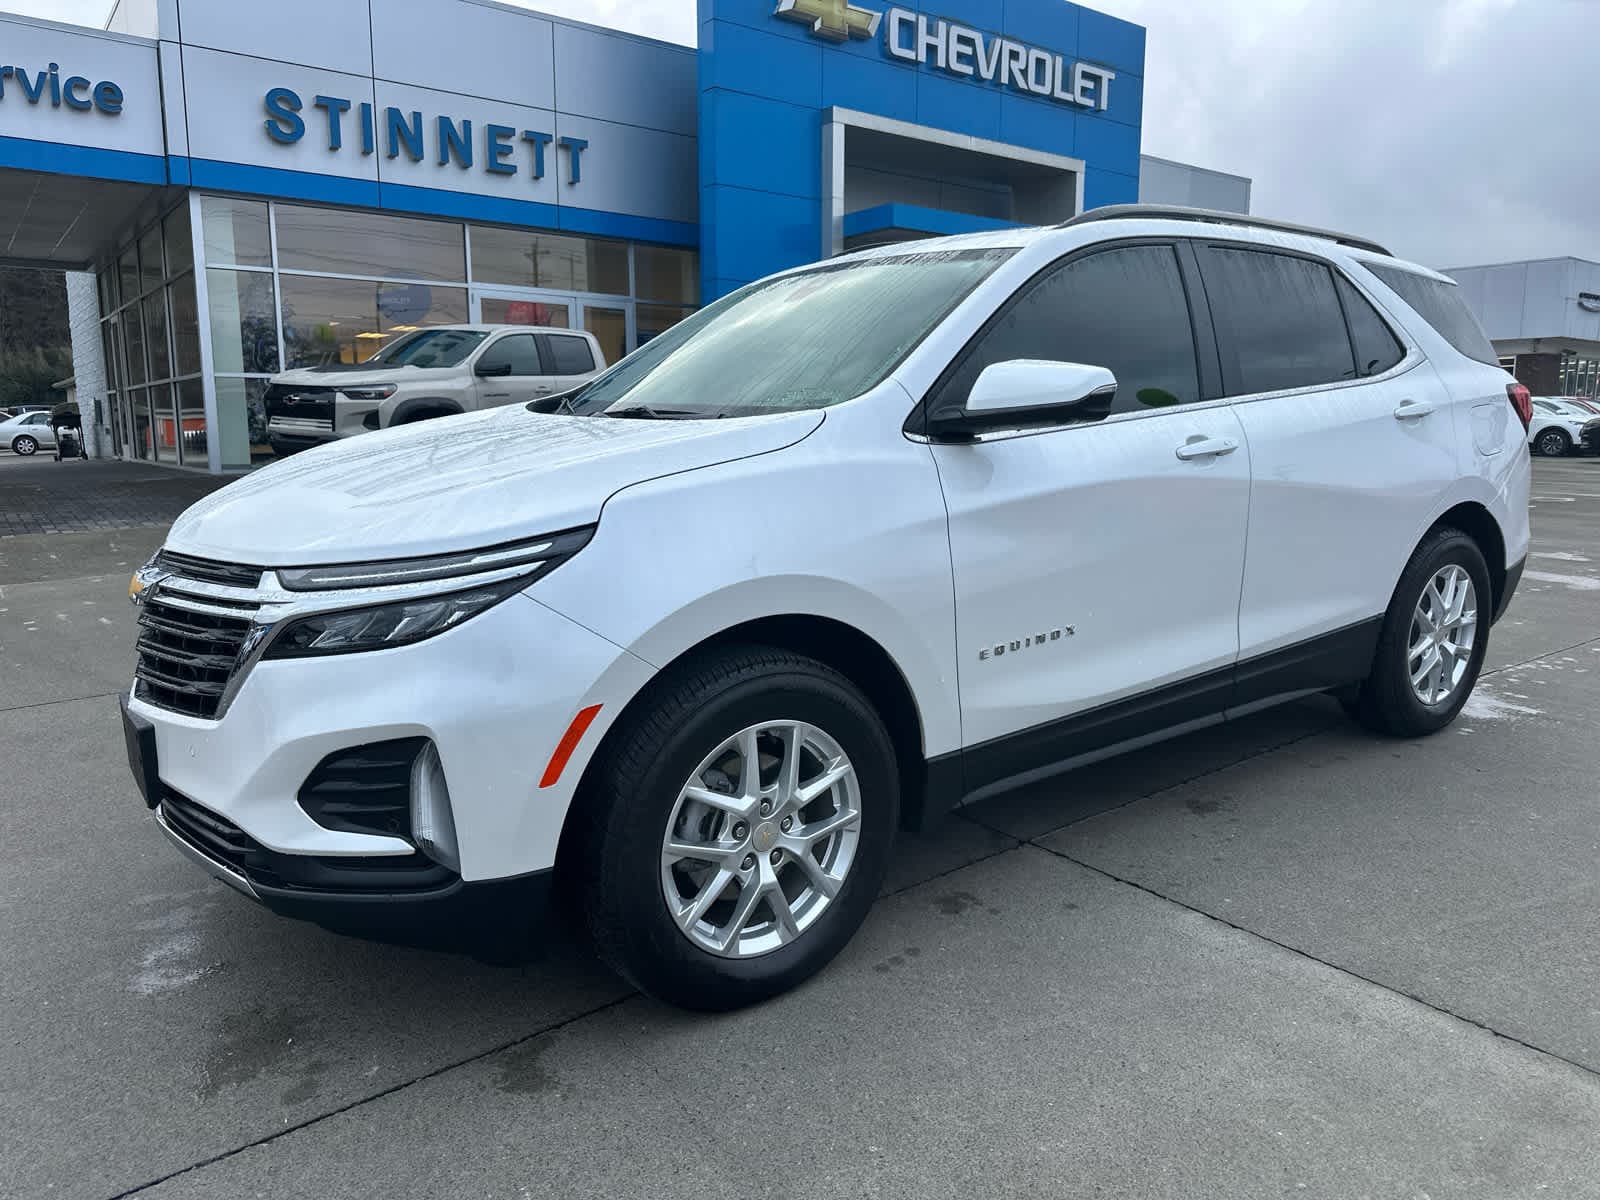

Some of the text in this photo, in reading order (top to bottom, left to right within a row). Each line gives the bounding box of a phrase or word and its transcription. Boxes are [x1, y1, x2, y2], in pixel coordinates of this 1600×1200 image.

[887, 7, 1116, 111] CHEVROLET
[264, 87, 588, 185] STINNETT
[979, 623, 1077, 661] EQUINOX
